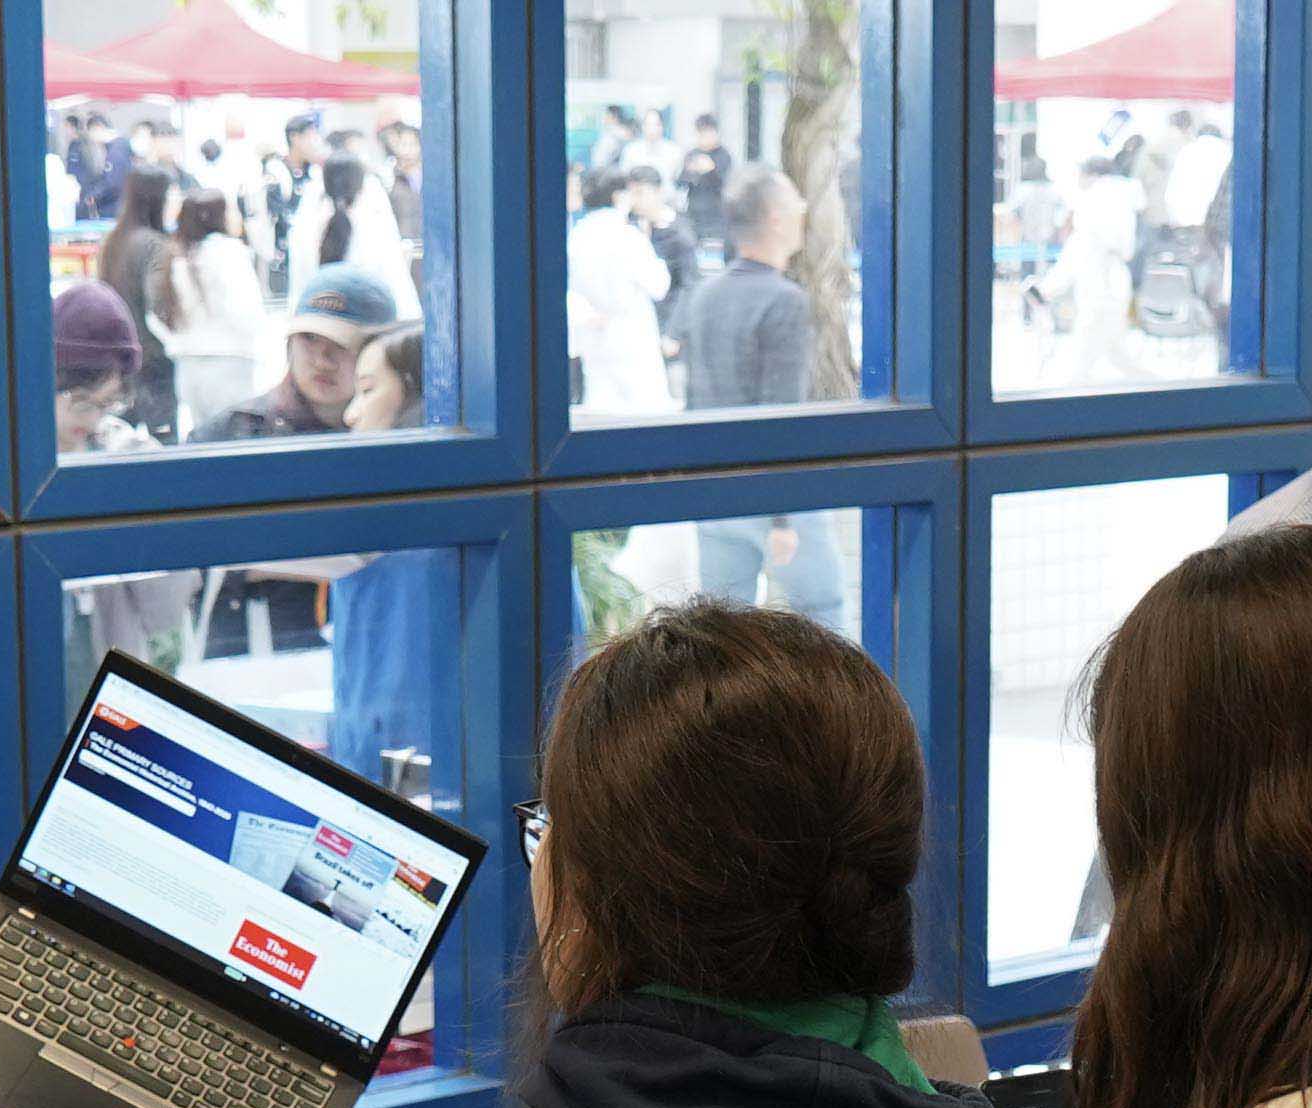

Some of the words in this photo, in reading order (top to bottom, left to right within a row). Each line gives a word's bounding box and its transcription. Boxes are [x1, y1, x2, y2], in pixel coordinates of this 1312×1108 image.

[314, 852, 338, 870] Brazil
[337, 866, 360, 883] takes
[236, 937, 305, 981] Economist
[265, 938, 288, 957] The
